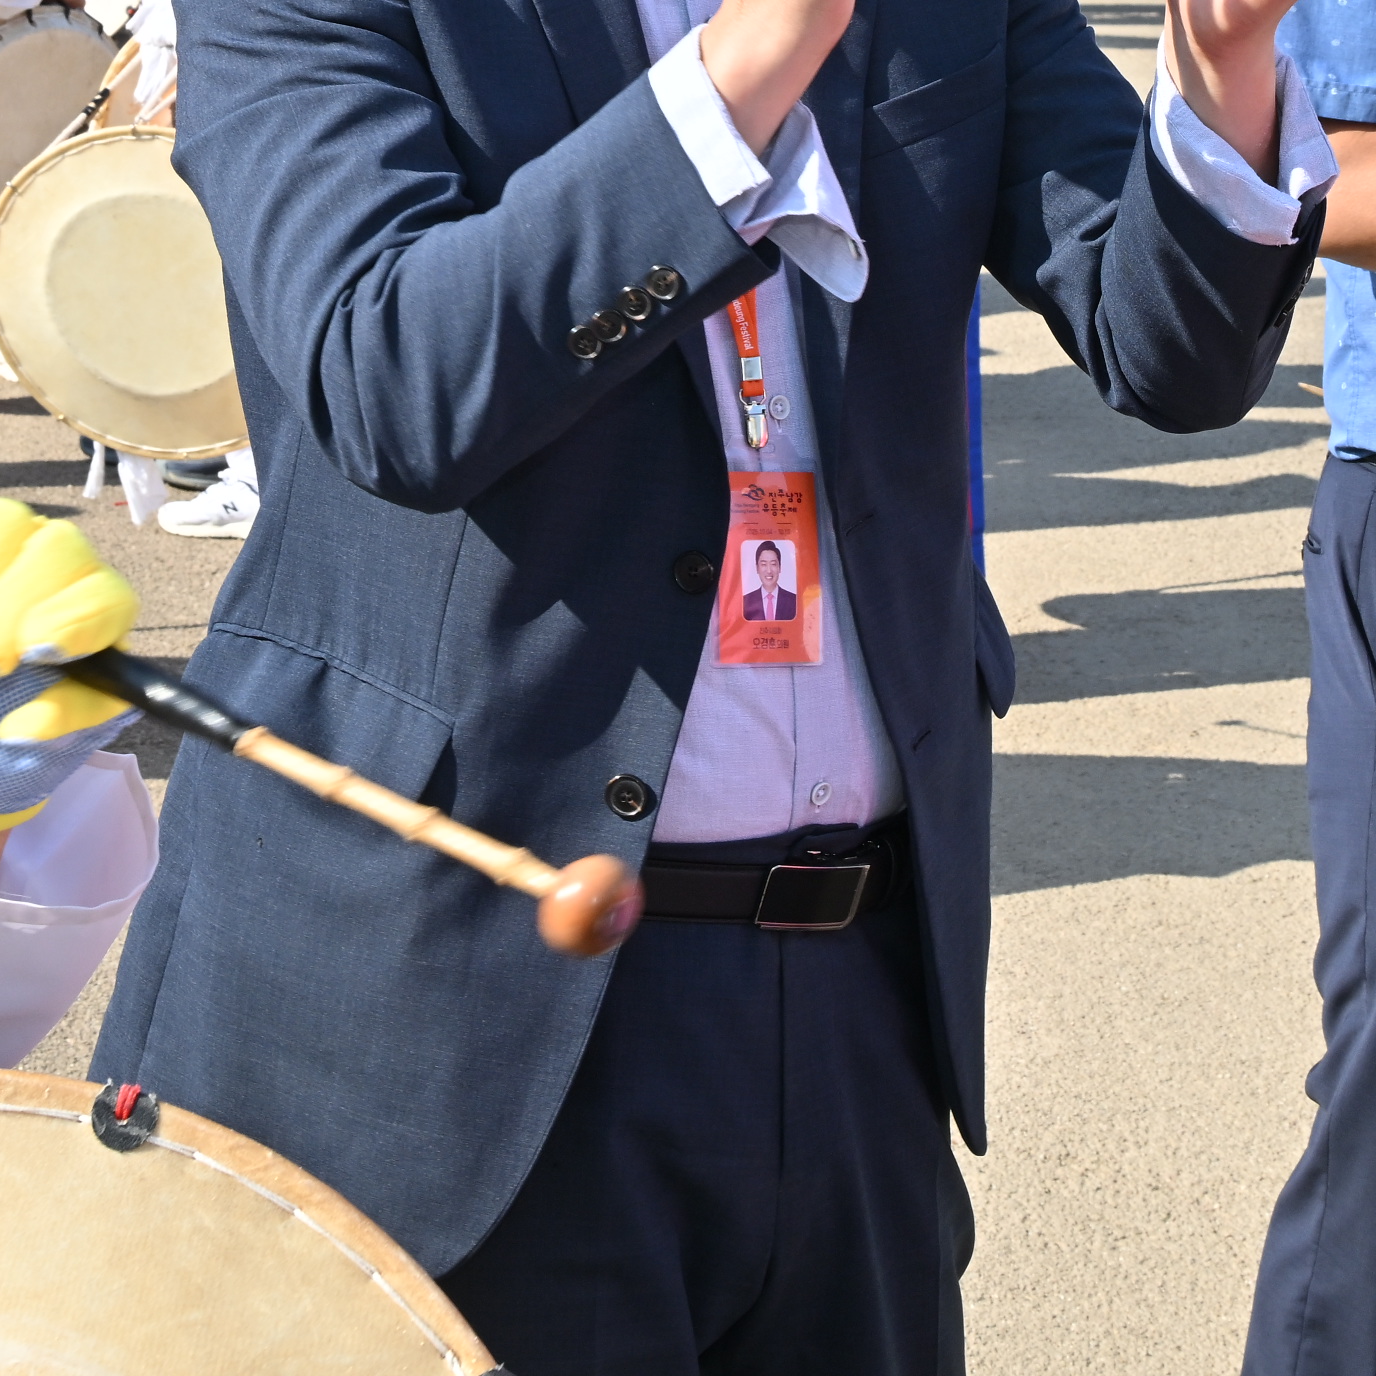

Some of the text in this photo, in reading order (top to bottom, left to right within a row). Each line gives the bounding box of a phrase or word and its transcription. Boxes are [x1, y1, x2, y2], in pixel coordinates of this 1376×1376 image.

[739, 321, 754, 351] Festival
[768, 488, 803, 504] 진주남강
[762, 503, 798, 517] 유등축제
